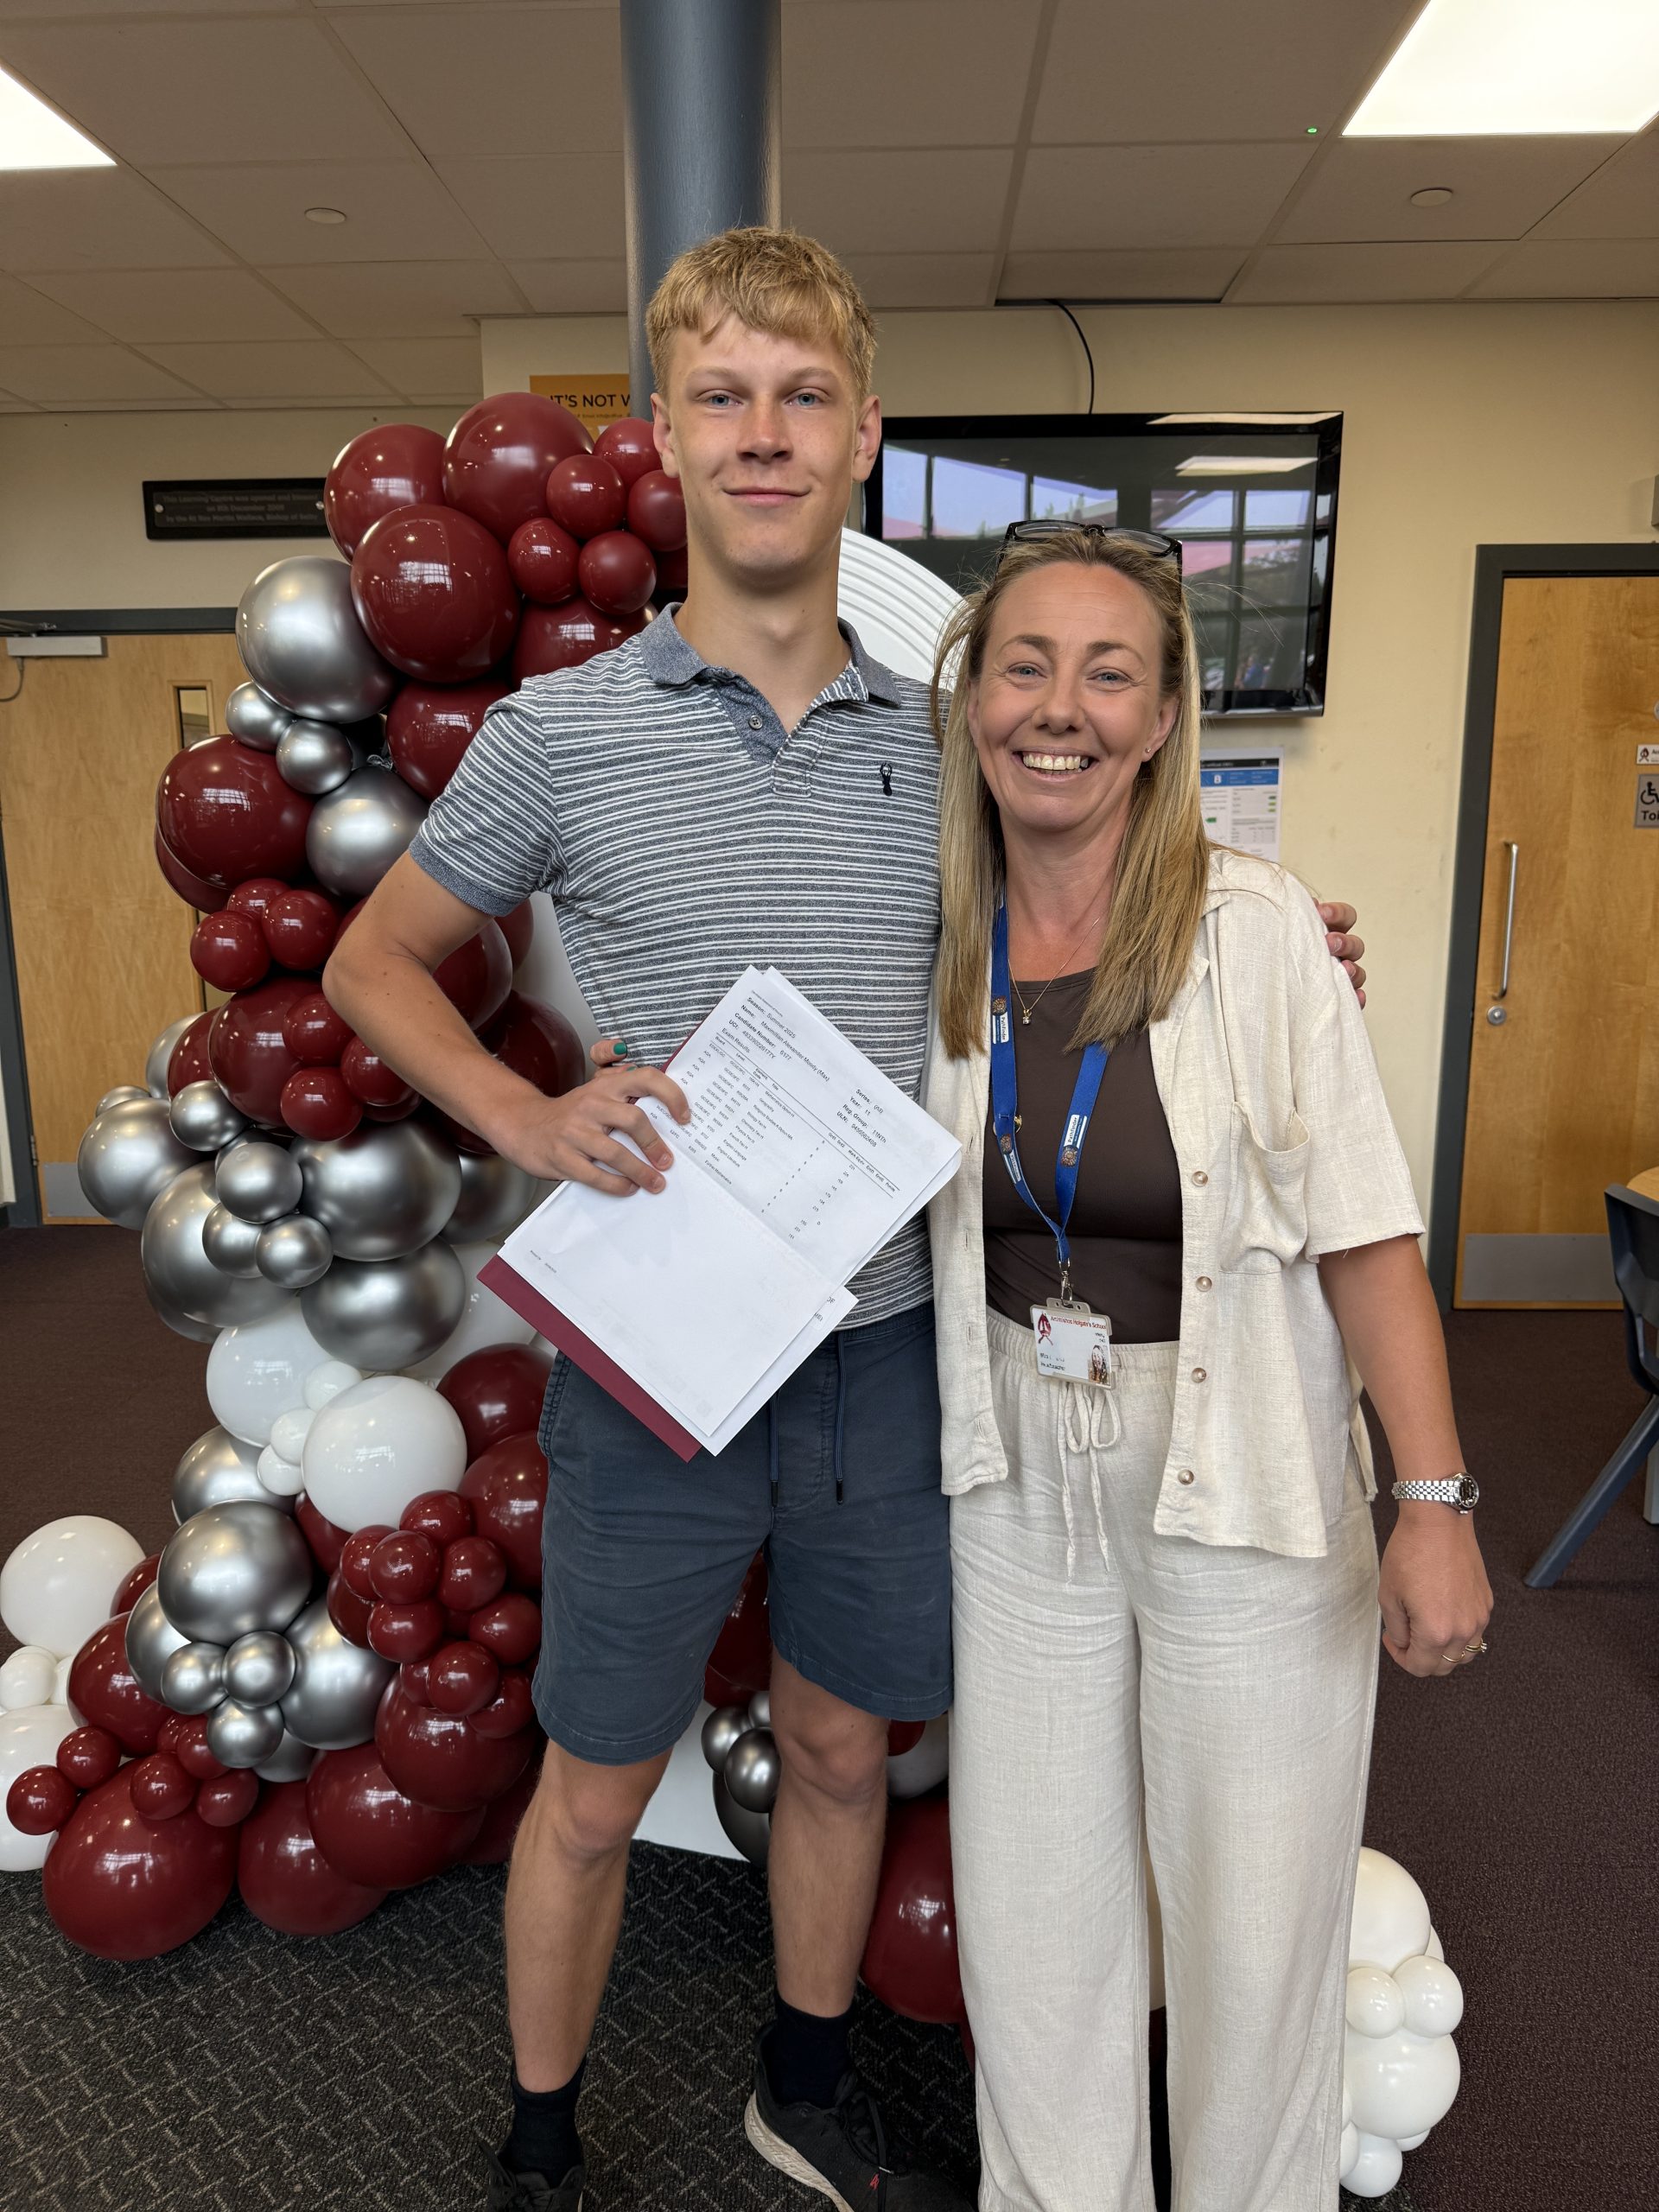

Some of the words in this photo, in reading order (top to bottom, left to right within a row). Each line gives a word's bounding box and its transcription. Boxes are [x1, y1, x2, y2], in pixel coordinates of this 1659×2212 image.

[582, 394, 617, 408] NOT
[735, 1013, 756, 1032] Candidate
[757, 1031, 775, 1046] Number:
[747, 998, 766, 1014] Season:
[767, 1014, 785, 1029] Summer
[785, 1028, 795, 1038] 2025
[722, 1028, 734, 1039] Exam
[734, 1039, 750, 1052] Results
[741, 1005, 753, 1018] Name:
[783, 1040, 804, 1058] Alexander
[804, 1058, 817, 1071] Moody
[817, 1070, 830, 1082] (Max)
[850, 1096, 861, 1107] Year:
[837, 1111, 848, 1122] ULN:
[854, 1114, 868, 1128] Group:
[1066, 1116, 1077, 1143] Pathfinder
